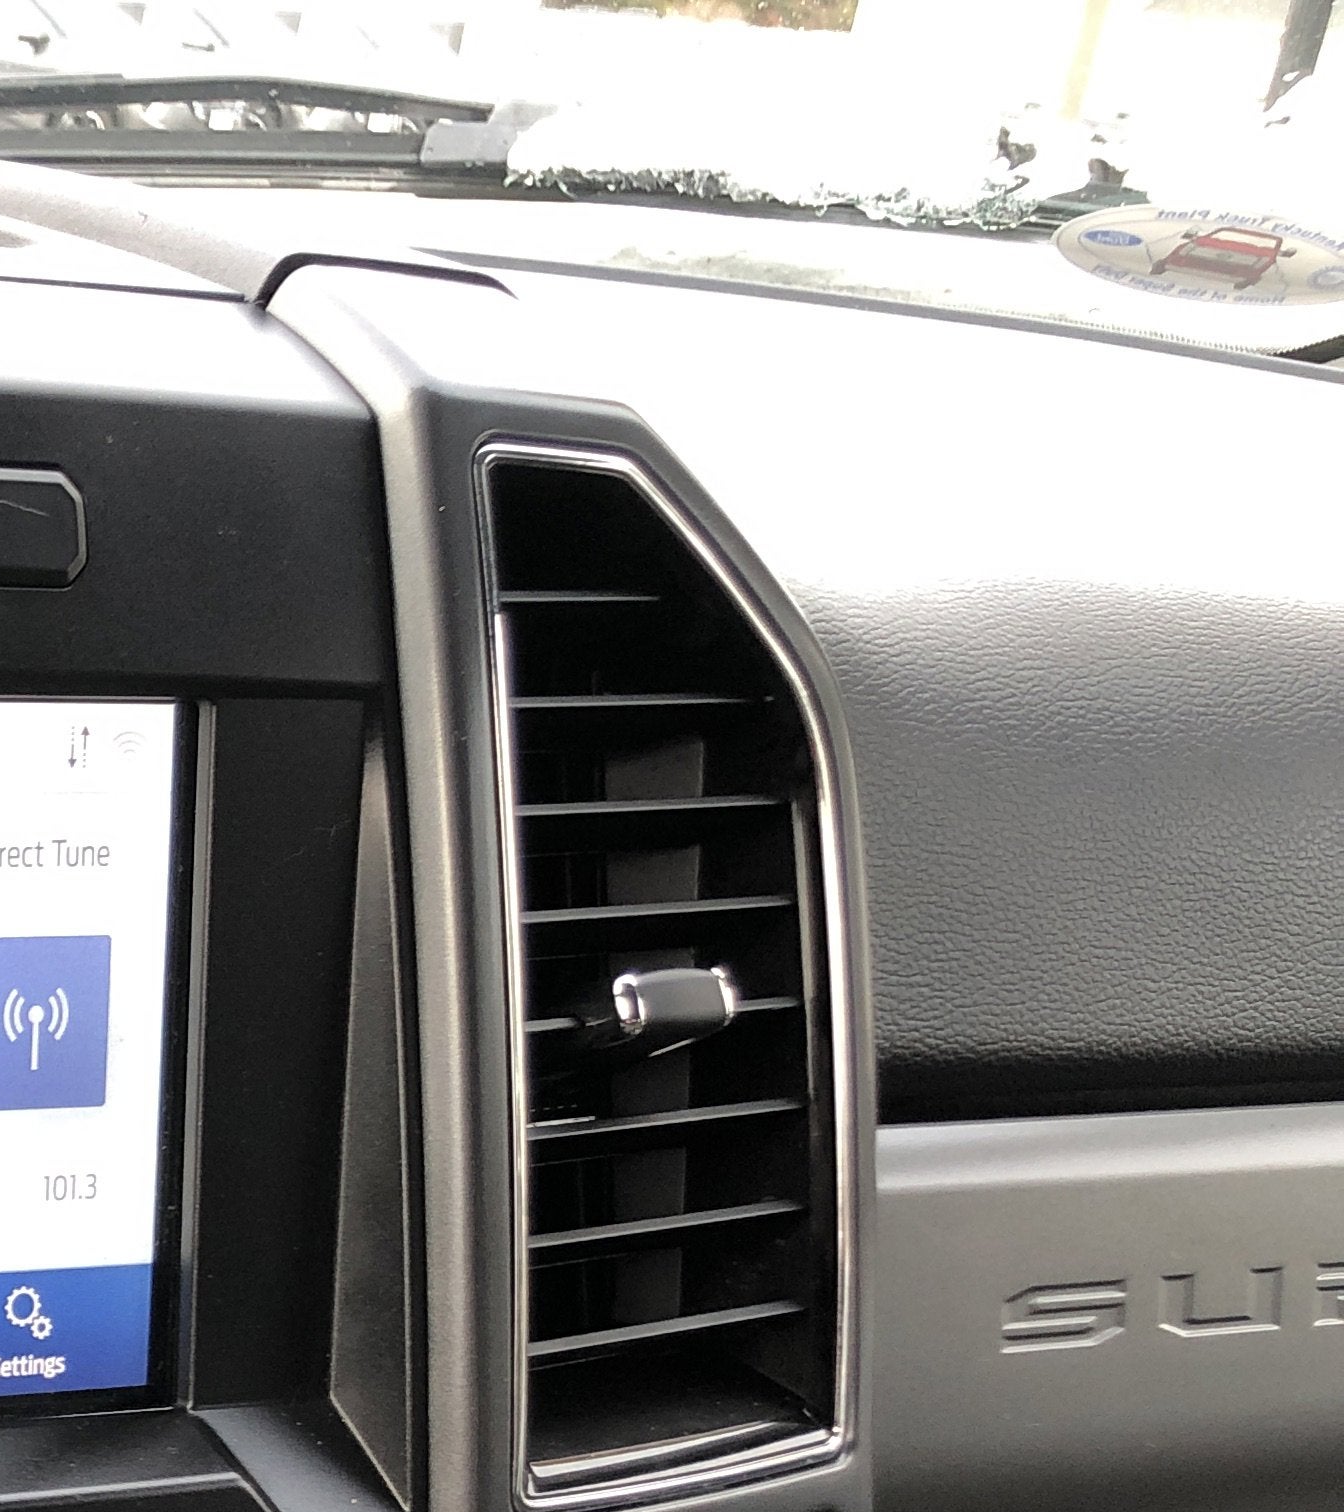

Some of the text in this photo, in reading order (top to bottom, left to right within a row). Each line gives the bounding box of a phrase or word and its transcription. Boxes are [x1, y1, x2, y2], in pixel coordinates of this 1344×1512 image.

[52, 839, 112, 868] Tune
[43, 1173, 97, 1202] 101.3
[1000, 1262, 1344, 1352] SU
